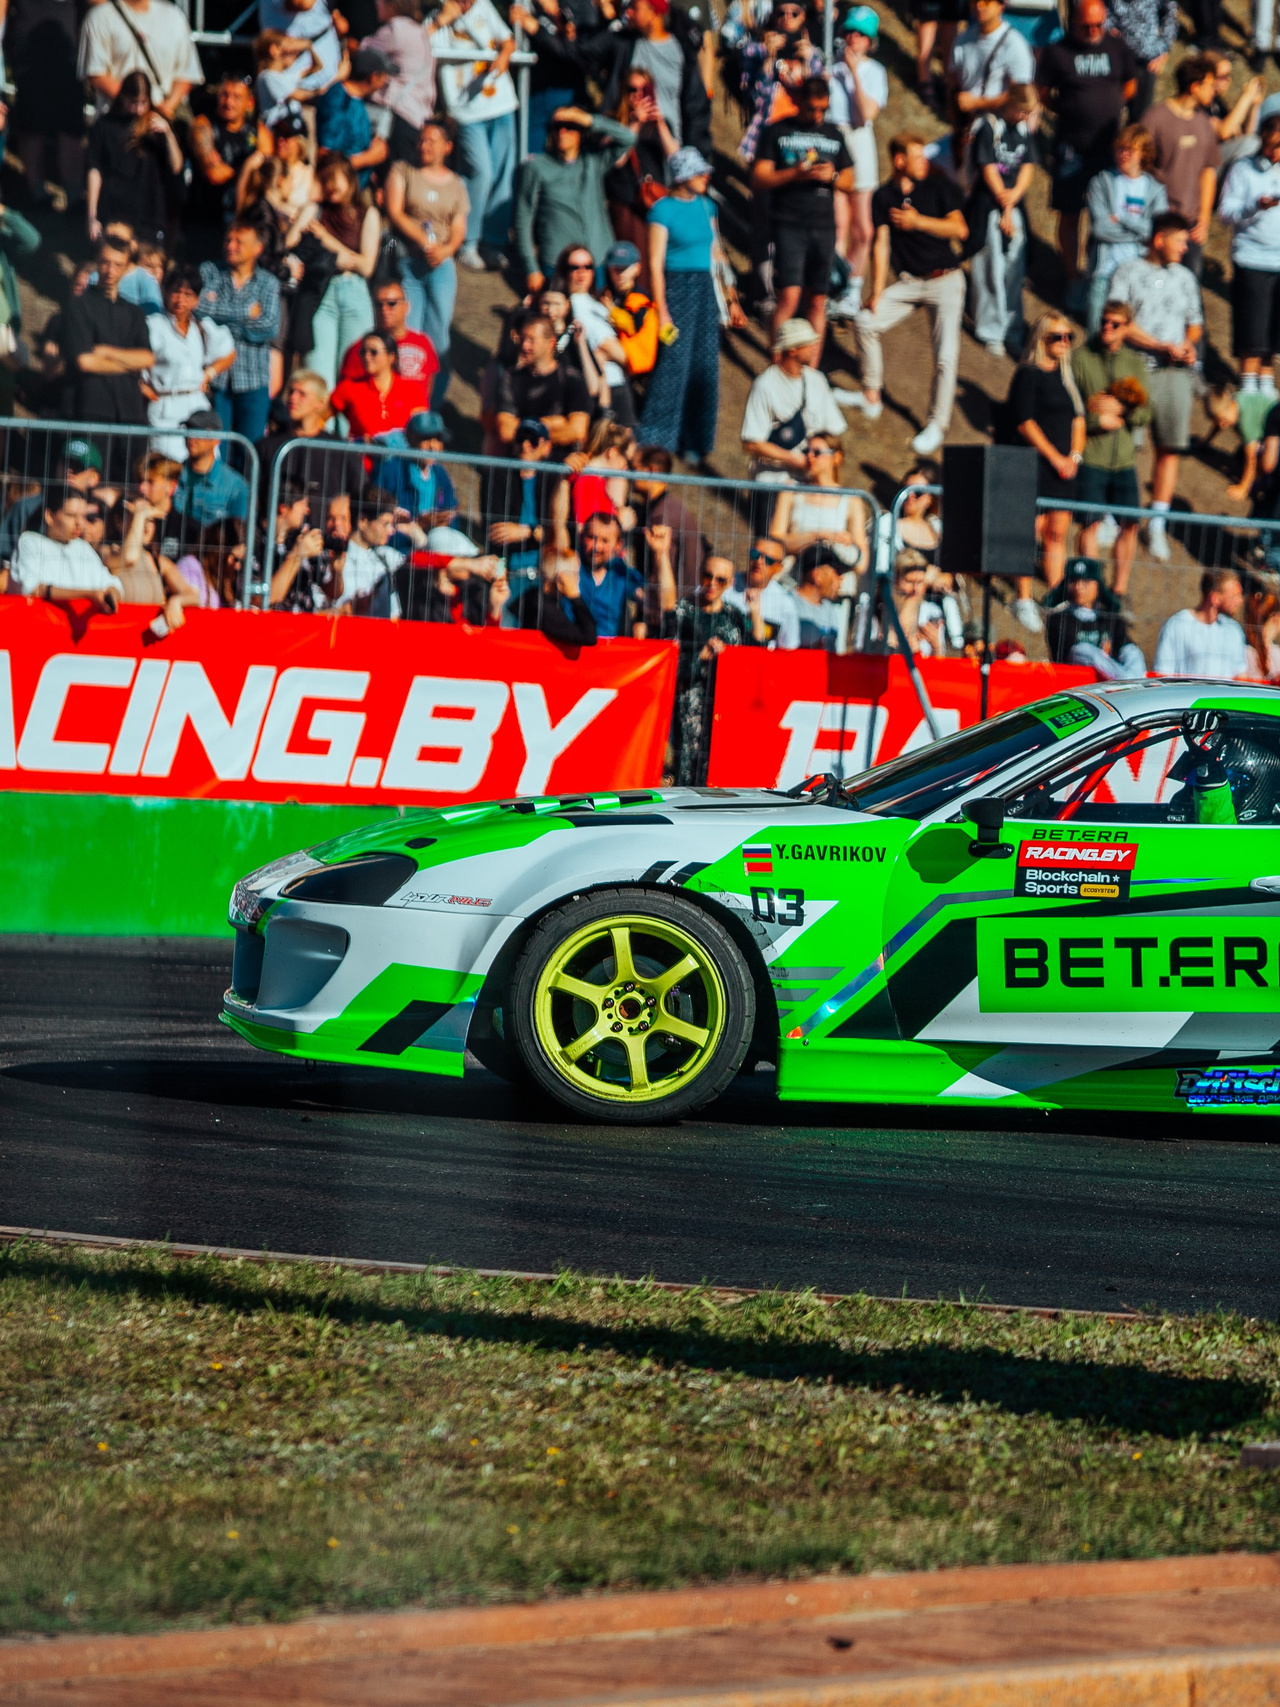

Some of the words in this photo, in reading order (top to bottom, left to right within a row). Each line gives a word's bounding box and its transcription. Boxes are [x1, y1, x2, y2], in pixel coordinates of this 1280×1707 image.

[0, 649, 618, 797] CING.BY
[775, 843, 887, 863] Y.GAVRIKOV
[1025, 846, 1131, 862] RACING.BY
[1025, 869, 1110, 883] Blockchain
[1024, 881, 1079, 895] Sports
